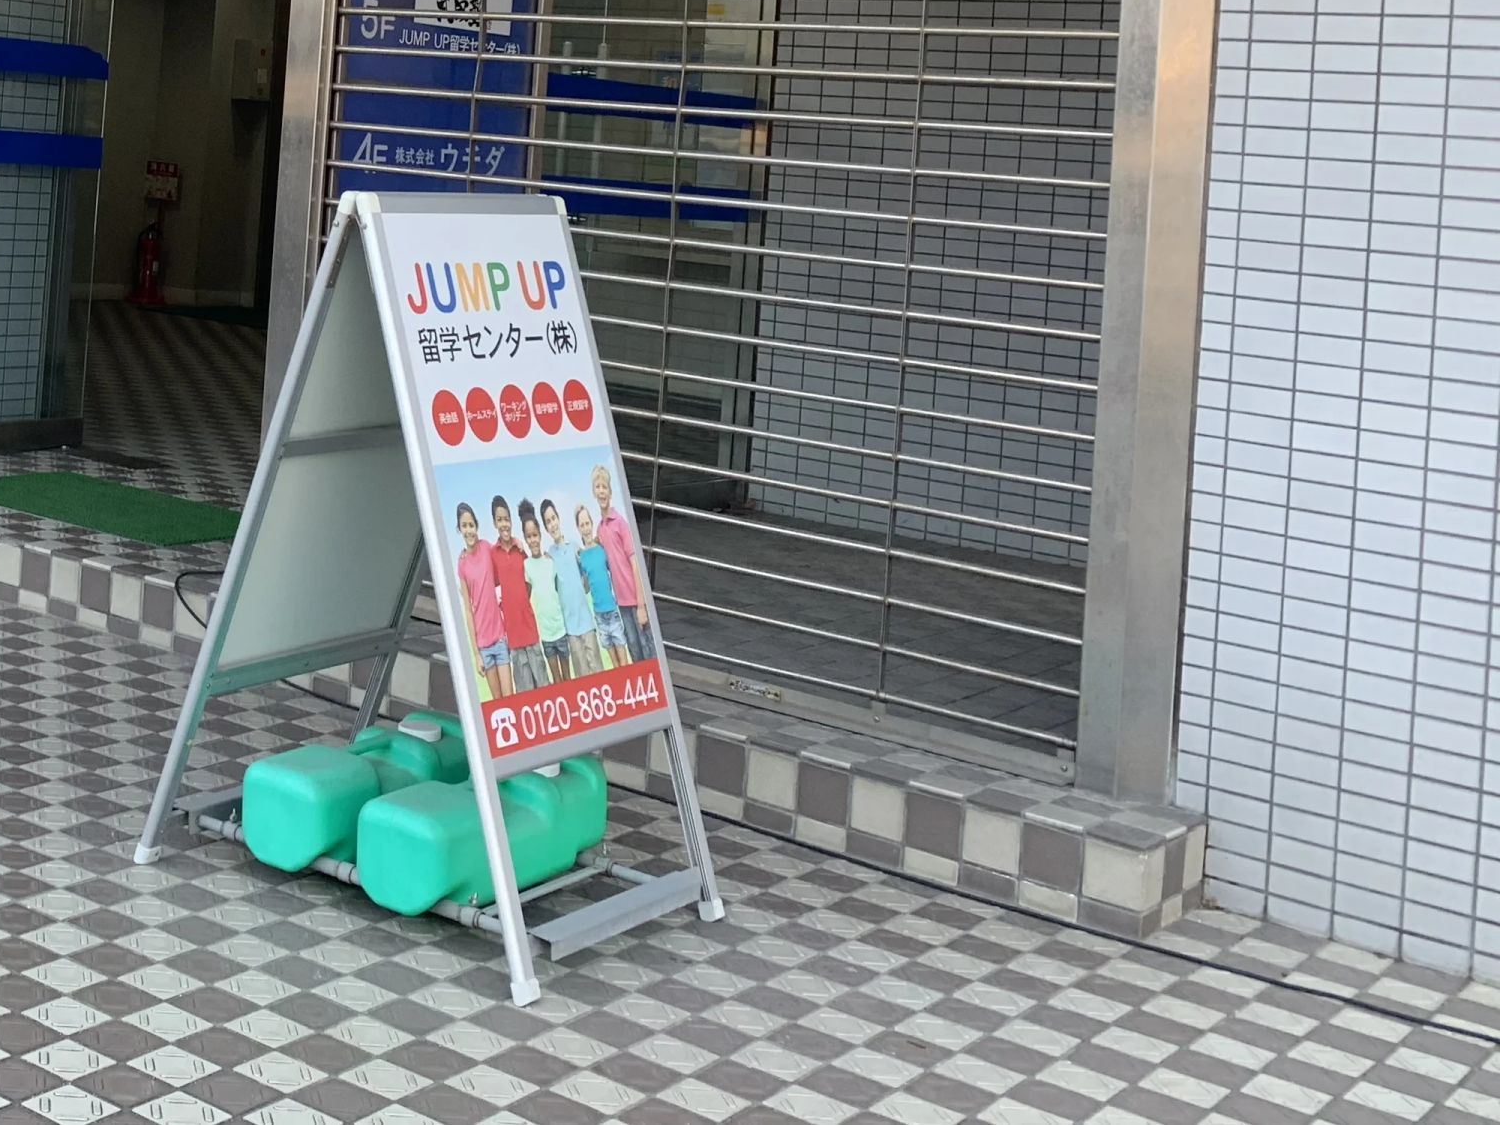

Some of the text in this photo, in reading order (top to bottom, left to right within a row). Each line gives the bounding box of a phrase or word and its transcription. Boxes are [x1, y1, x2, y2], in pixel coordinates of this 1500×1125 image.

[399, 28, 431, 47] JUMP
[352, 132, 389, 174] 4F
[407, 260, 565, 315] JUMP UP
[466, 409, 497, 421] ホームステイ
[500, 400, 527, 412] ワーキング
[520, 672, 659, 740] 0120-868-444
